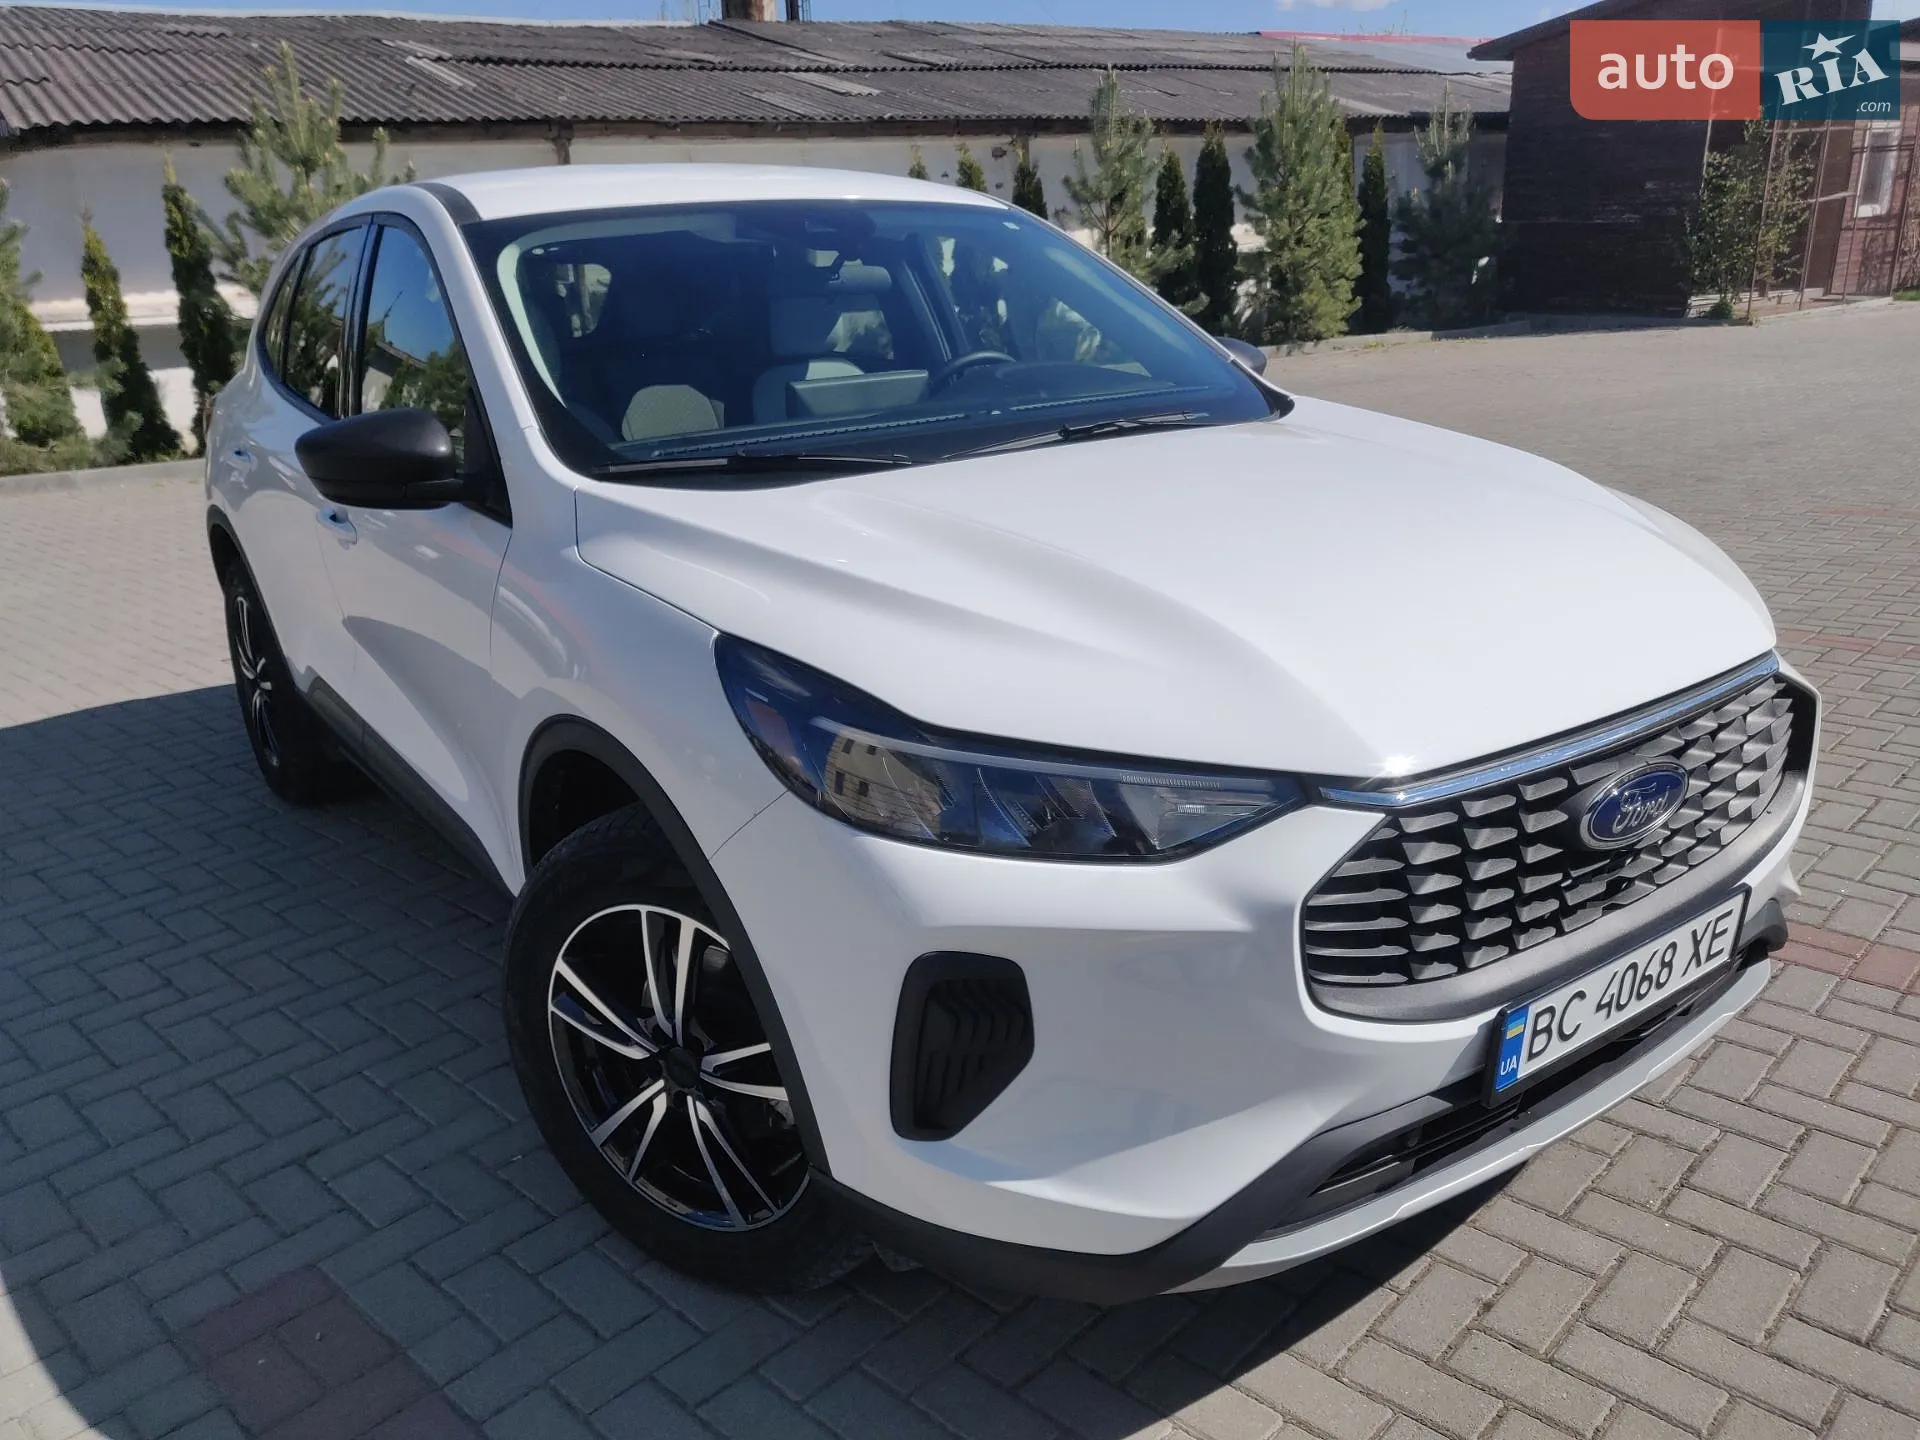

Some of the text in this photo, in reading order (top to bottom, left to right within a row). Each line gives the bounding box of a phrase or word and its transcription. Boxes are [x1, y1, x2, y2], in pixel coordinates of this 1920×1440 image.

[1612, 782, 1671, 834] Ford
[1526, 908, 1733, 1062] BC 4068 XE
[1500, 1060, 1518, 1076] UA
